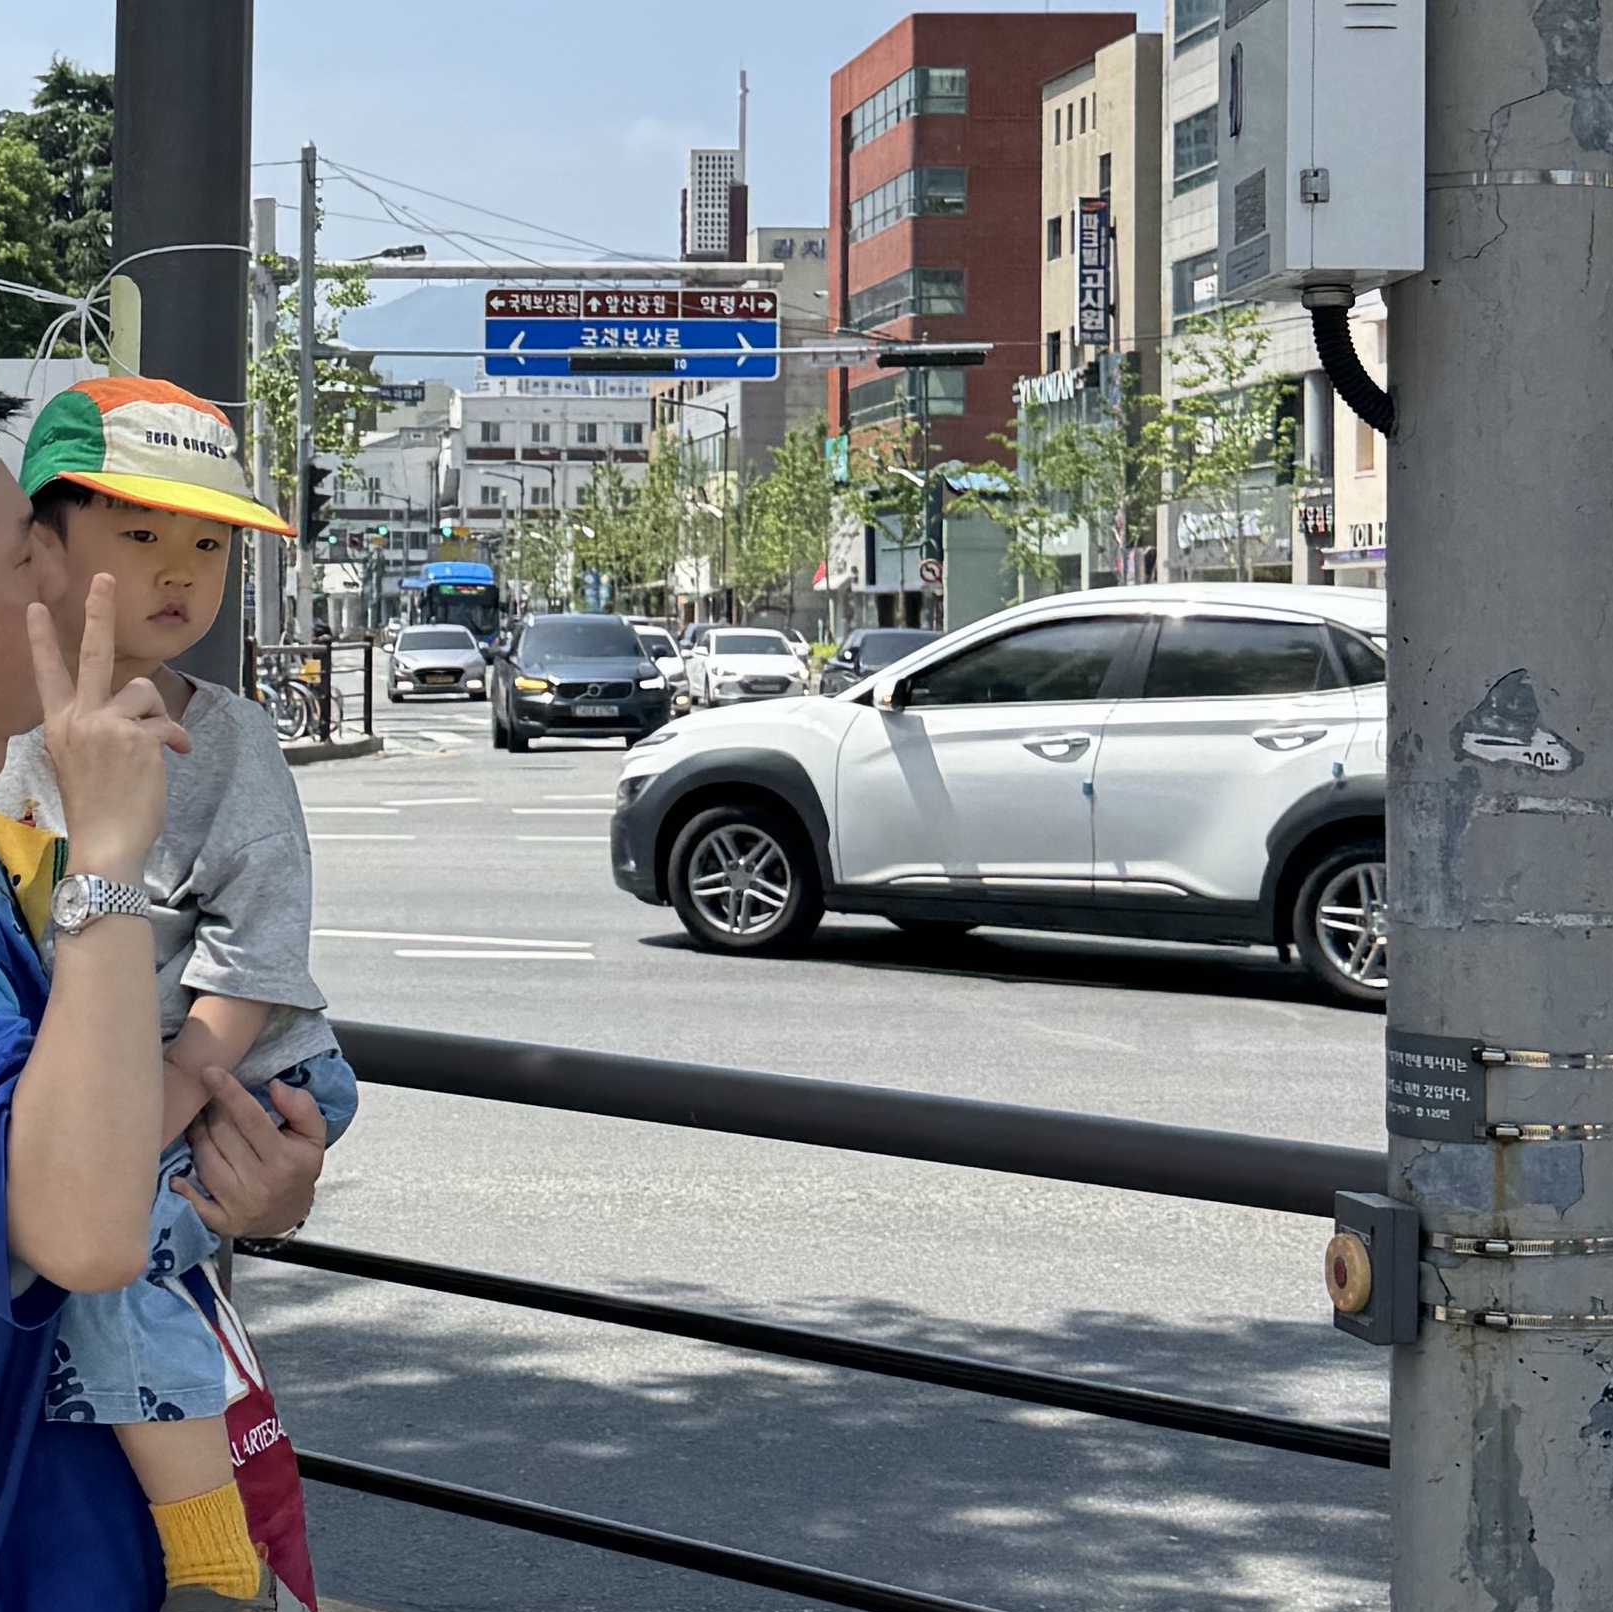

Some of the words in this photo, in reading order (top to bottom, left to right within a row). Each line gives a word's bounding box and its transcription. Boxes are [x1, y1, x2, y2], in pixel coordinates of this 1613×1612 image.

[509, 294, 579, 314] 국채보상공원
[605, 294, 666, 315] 앞산공원
[700, 294, 755, 315] 약령시
[580, 327, 682, 349] 국채보상로
